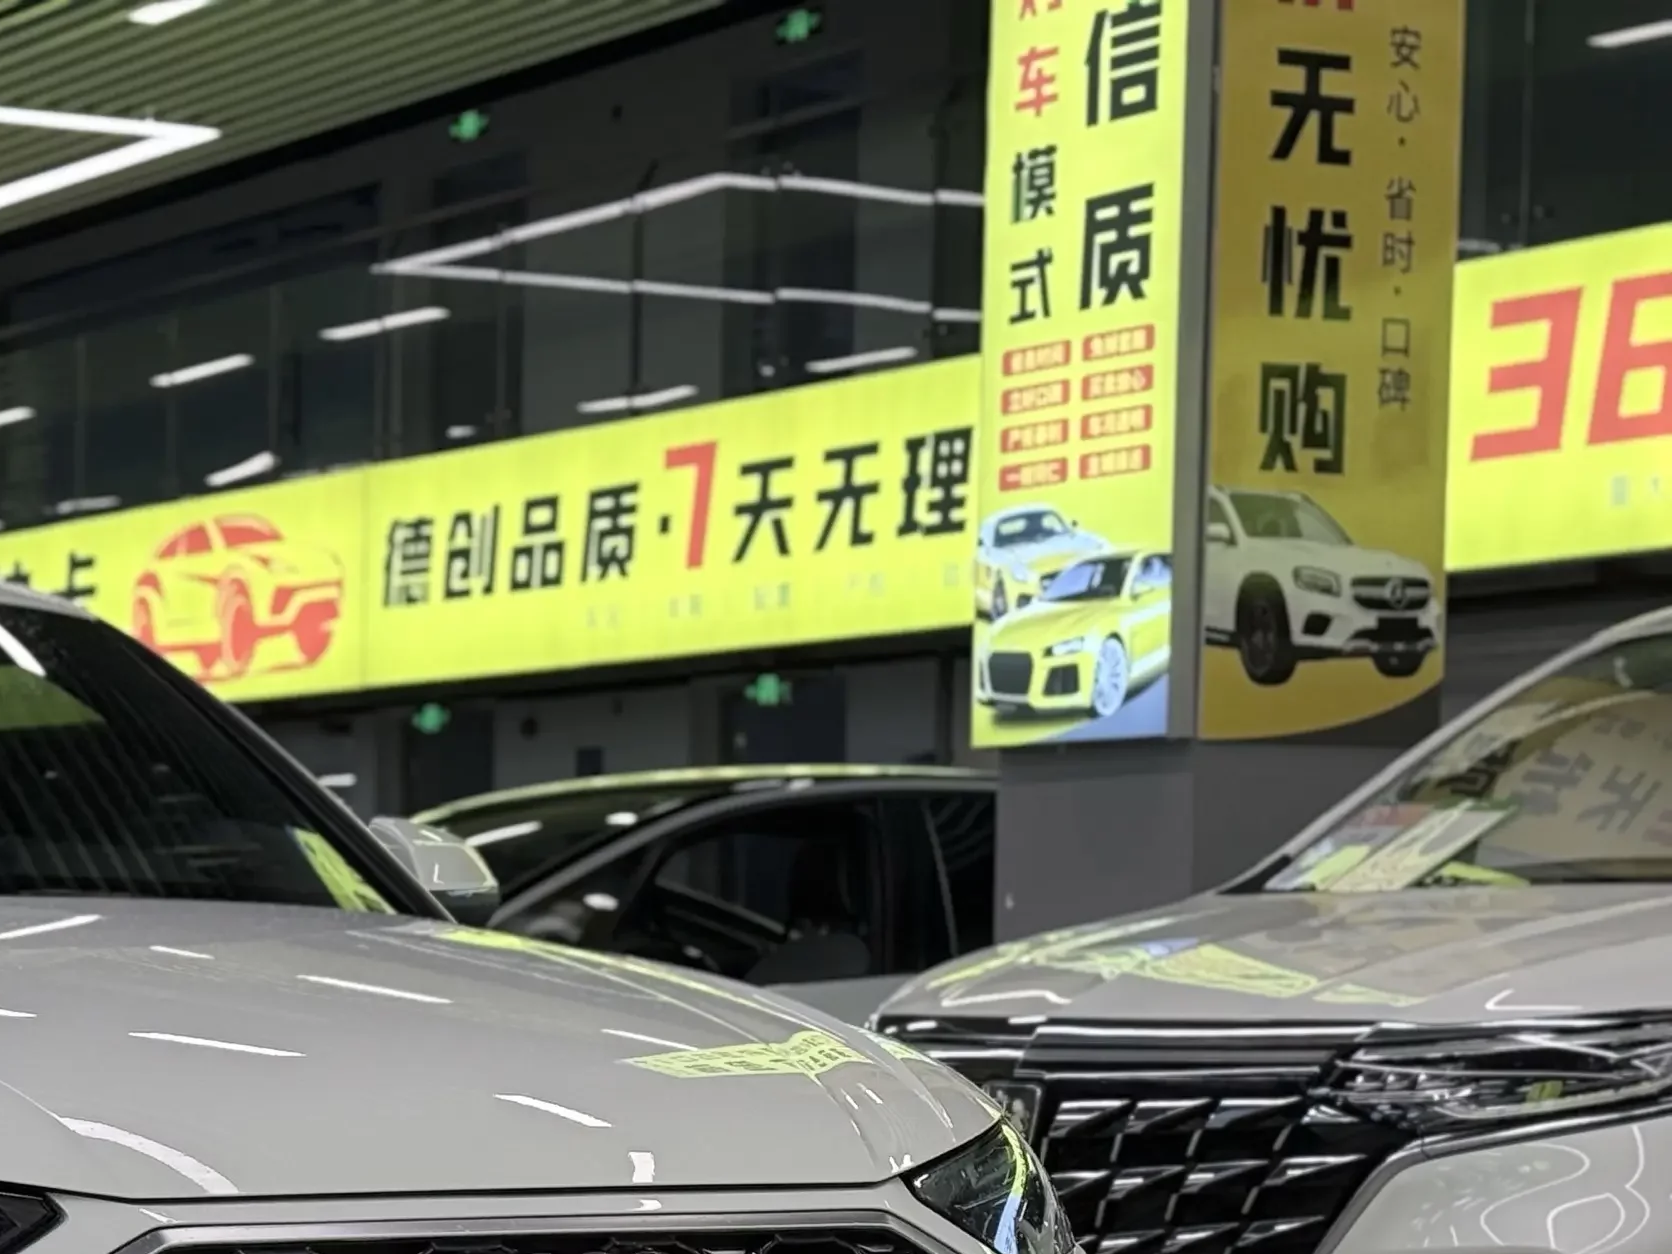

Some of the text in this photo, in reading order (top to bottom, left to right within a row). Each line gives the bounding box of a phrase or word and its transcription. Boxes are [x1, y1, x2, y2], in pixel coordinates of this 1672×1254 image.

[1009, 0, 1064, 325] 车模式
[1259, 0, 1356, 475] 无忧购
